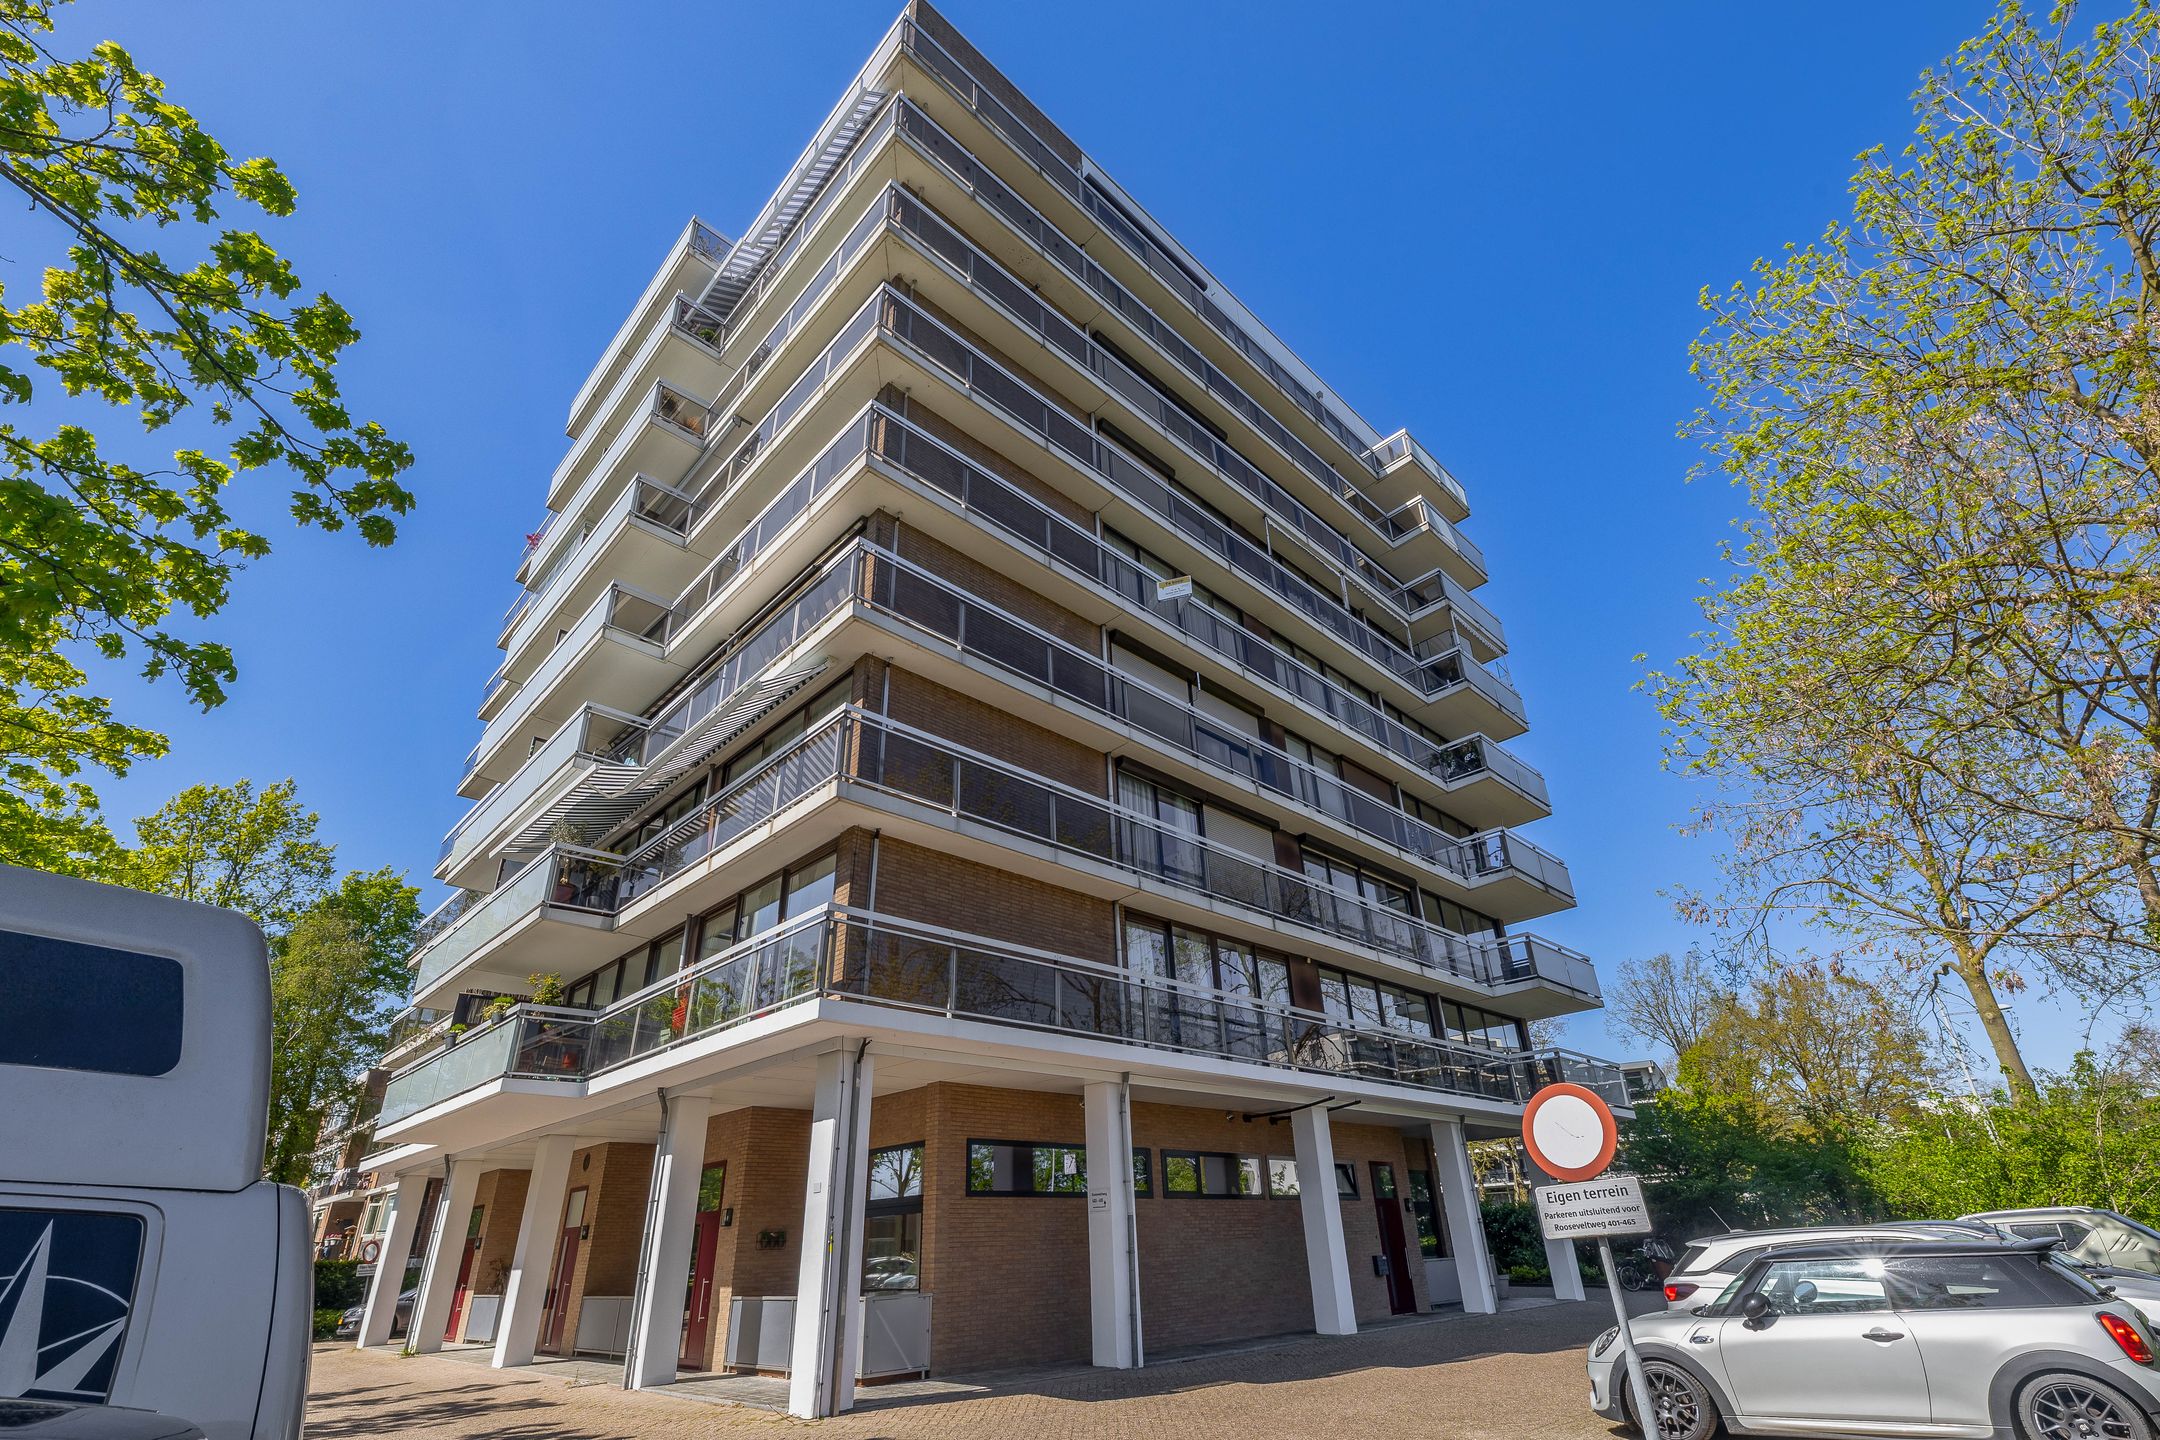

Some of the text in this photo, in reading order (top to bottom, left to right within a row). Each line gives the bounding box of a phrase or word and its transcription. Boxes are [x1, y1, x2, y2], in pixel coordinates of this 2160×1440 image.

[1546, 1185, 1629, 1205] Eigen terrein
[1544, 1205, 1640, 1220] Parkeren uitsluitend voor
[1554, 1218, 1636, 1232] Rooseveltweg 401-465
